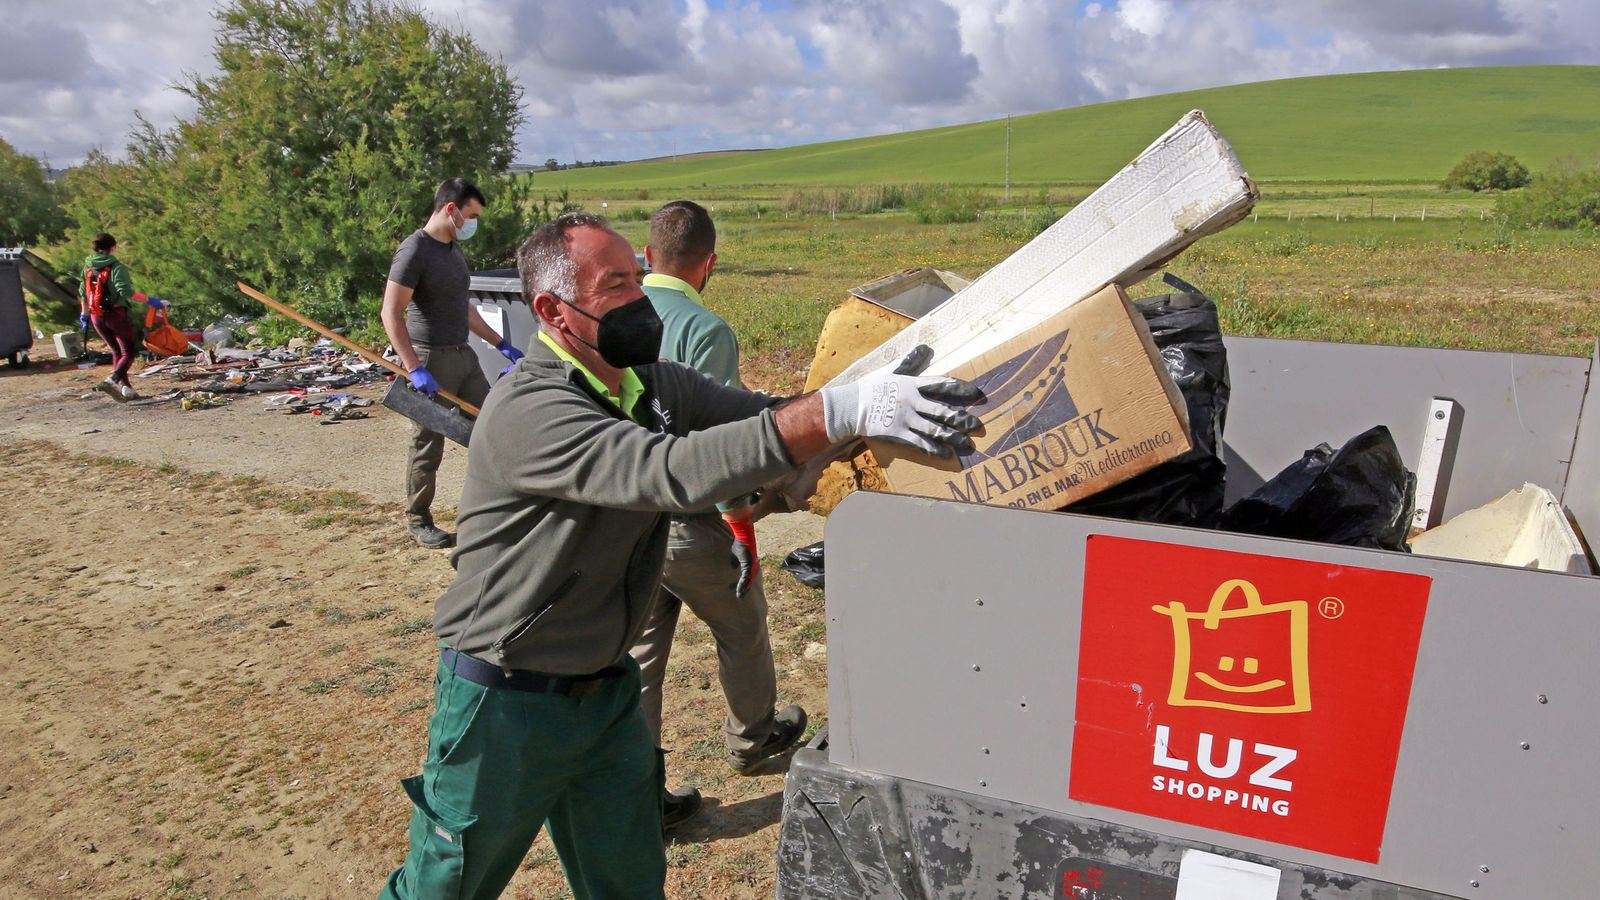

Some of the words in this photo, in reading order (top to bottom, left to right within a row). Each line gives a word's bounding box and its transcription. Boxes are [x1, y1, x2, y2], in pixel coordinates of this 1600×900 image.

[945, 408, 1119, 503] MABROUK
[1026, 490, 1043, 506] EN
[1041, 486, 1055, 499] EL
[1054, 473, 1082, 493] MAR
[1075, 430, 1174, 479] Mediterraneo
[1153, 725, 1297, 791] LUZ
[1152, 775, 1289, 816] SHOPPING
